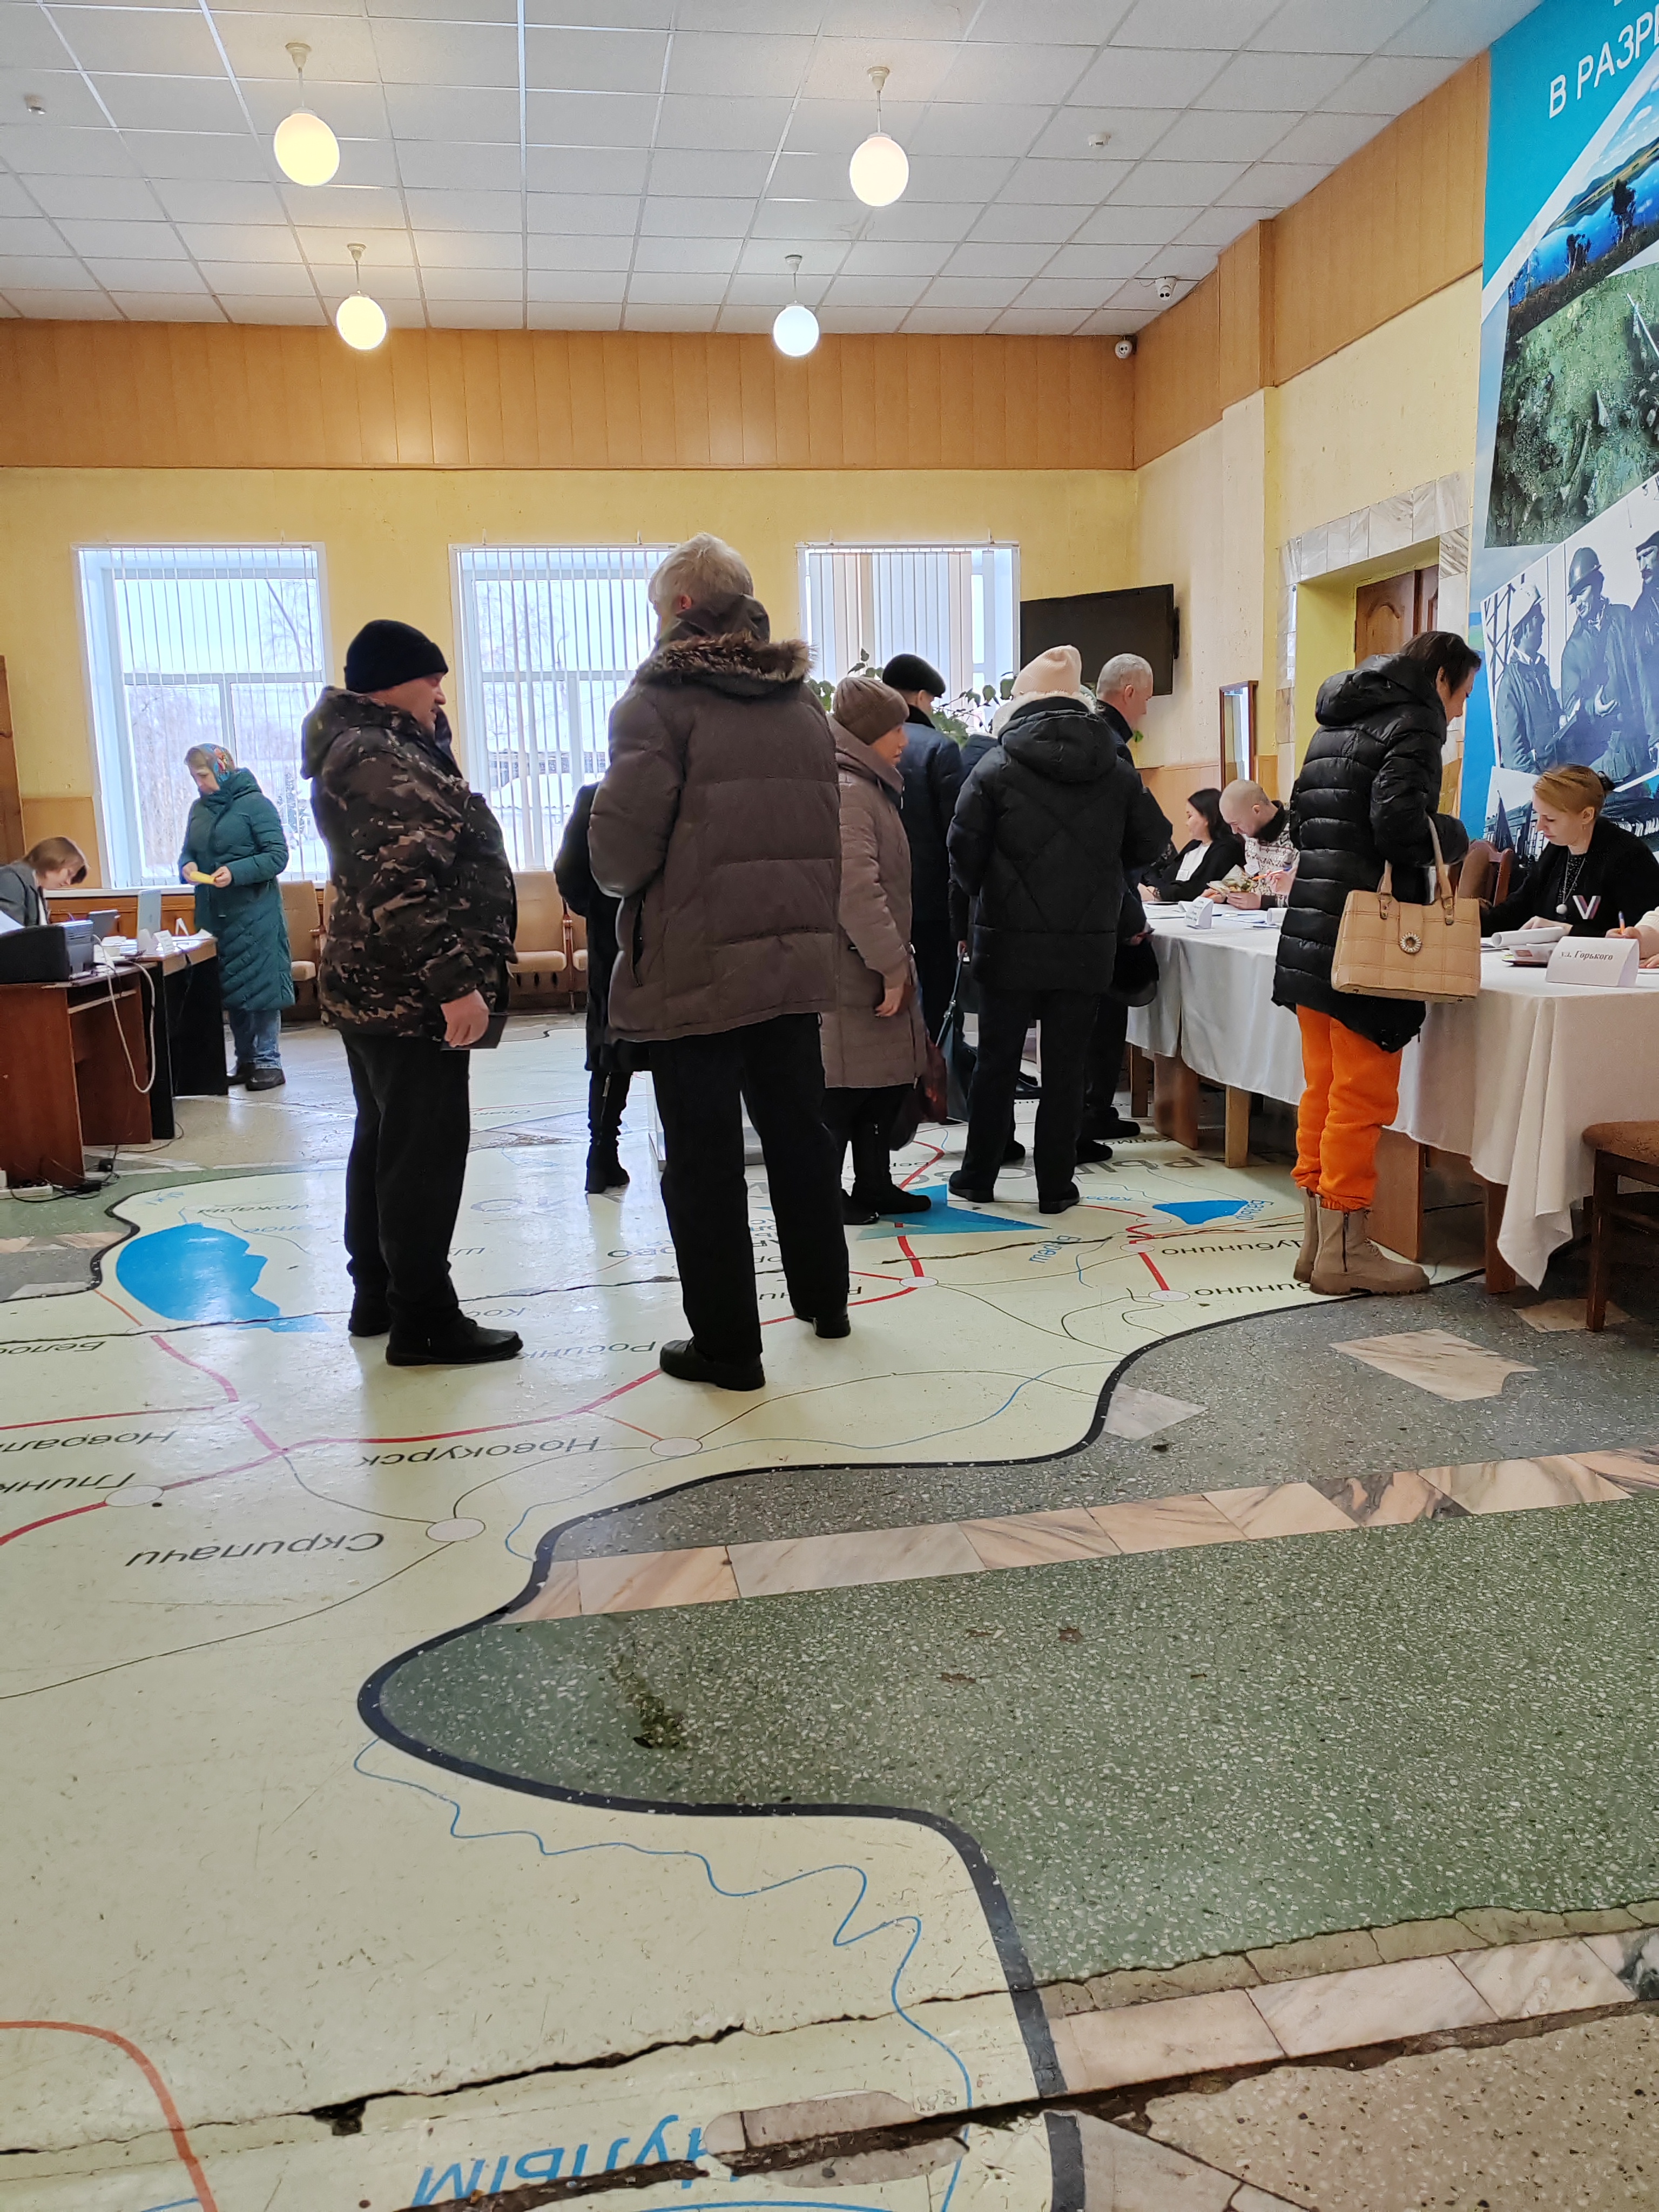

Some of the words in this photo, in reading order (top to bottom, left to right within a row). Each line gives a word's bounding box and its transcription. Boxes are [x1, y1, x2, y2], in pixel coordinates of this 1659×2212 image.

[1549, 74, 1567, 119] В
[1574, 950, 1613, 961] Горького
[354, 1435, 600, 1468] Новокурск
[124, 1532, 385, 1567] Скрипачи
